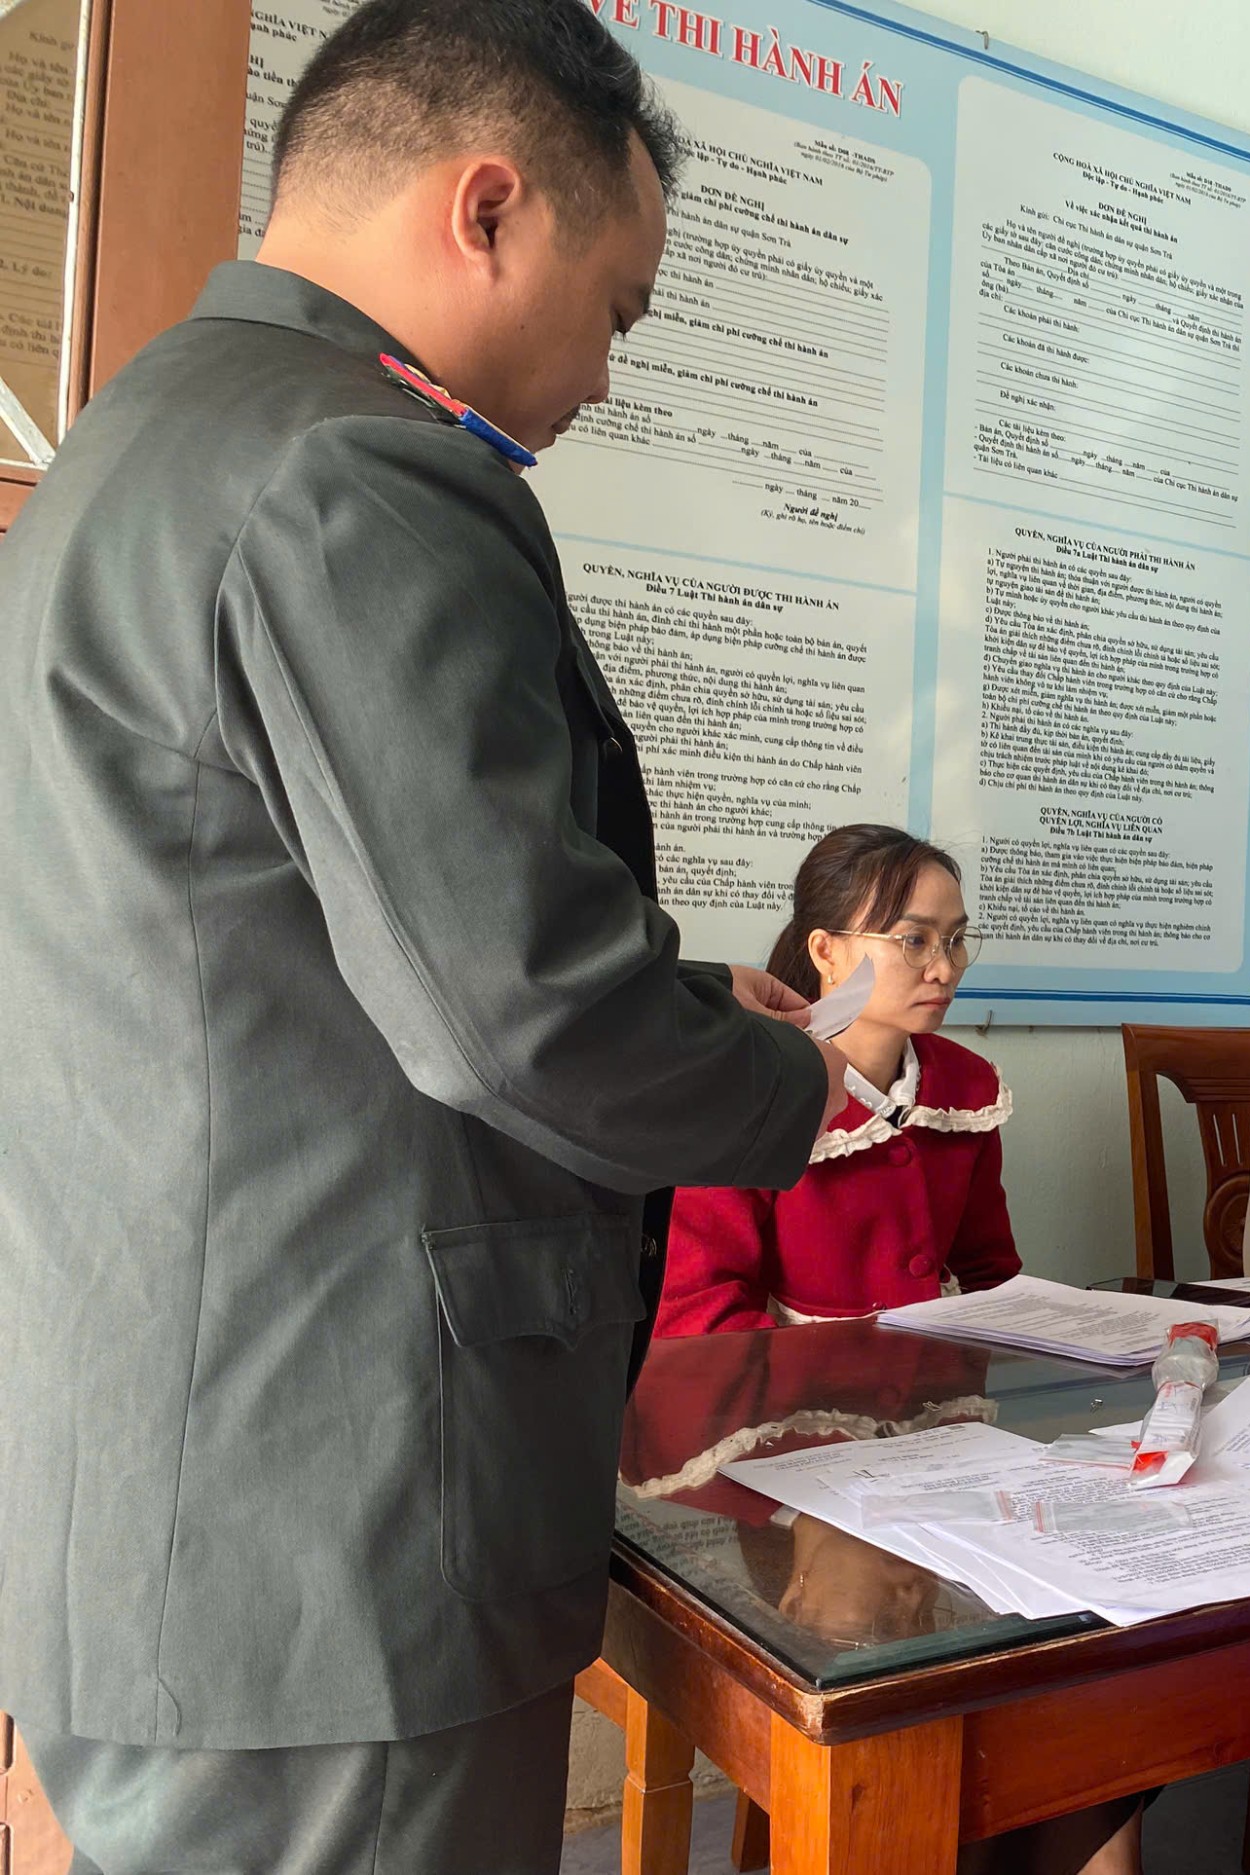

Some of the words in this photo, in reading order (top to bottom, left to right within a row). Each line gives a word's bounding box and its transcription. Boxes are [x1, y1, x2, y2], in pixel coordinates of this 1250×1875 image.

[650, 0, 721, 56] THI
[732, 27, 844, 97] HÀNH
[850, 61, 903, 117] ÁN
[694, 140, 706, 150] XÃ
[709, 145, 726, 158] HỘI
[728, 151, 746, 162] CHỦ
[750, 157, 779, 172] NGHĨA
[780, 166, 800, 178] VIỆT
[803, 173, 822, 185] NAM
[729, 161, 739, 170] do
[1052, 152, 1074, 165] CỘNG
[1104, 169, 1117, 181] HỘI
[1135, 180, 1157, 193] NGHĨA
[1158, 188, 1174, 198] VIỆT
[1175, 193, 1191, 205] NAM
[700, 185, 721, 196] ĐƠN
[740, 195, 764, 211] NGHỊ
[761, 209, 775, 223] chế
[777, 218, 788, 226] thi
[789, 221, 809, 233] hành
[811, 227, 821, 236] án
[822, 231, 837, 240] dân
[839, 236, 848, 245] sự
[1098, 202, 1114, 212] ĐƠN
[1127, 211, 1146, 225] NGHỊ
[681, 210, 700, 222] hành
[702, 217, 712, 225] án
[713, 219, 728, 230] dân
[730, 225, 739, 234] sự
[740, 229, 759, 238] quận
[761, 232, 776, 243] Sơn
[778, 236, 791, 247] Trà
[614, 399, 631, 412] liệu
[633, 402, 651, 413] kèm
[654, 407, 672, 417] theo
[765, 483, 783, 493] ngày
[796, 488, 817, 500] tháng
[832, 496, 848, 505] năm
[784, 503, 808, 514] Người
[1046, 534, 1072, 545] NGHĨA
[1073, 539, 1084, 551] VỤ
[1085, 541, 1101, 552] CỦA
[1103, 545, 1128, 557] NGƯỜI
[1148, 555, 1161, 563] THI
[1163, 558, 1184, 568] HÀNH
[1185, 561, 1195, 570] ÁN
[627, 570, 662, 584] NGHĨA
[664, 575, 680, 589] VỤ
[681, 577, 704, 589] CỦA
[706, 582, 740, 594] NGƯỜI
[743, 587, 772, 600] ĐƯỢC
[775, 592, 792, 602] THI
[795, 596, 823, 607] HÀNH
[826, 599, 838, 609] ÁN
[646, 583, 666, 594] Điều
[677, 588, 698, 599] Luật
[700, 591, 715, 601] Thi
[718, 594, 739, 605] hành
[742, 598, 752, 607] án
[754, 600, 770, 610] dân
[773, 605, 783, 613] sự
[566, 594, 589, 607] gười
[590, 596, 613, 610] được
[614, 599, 626, 607] thi
[628, 600, 649, 610] hành
[651, 603, 662, 612] án
[664, 606, 675, 614] có
[676, 608, 690, 616] các
[692, 610, 719, 623] quyền
[720, 615, 733, 623] sau
[735, 616, 752, 626] đây:
[588, 629, 611, 641] trong
[613, 631, 634, 644] Luật
[636, 635, 654, 647] này;
[601, 663, 616, 674] địa
[645, 668, 678, 681] phương
[679, 672, 700, 683] thức,
[702, 675, 716, 685] nội
[718, 677, 738, 689] dung
[740, 680, 751, 688] thi
[753, 680, 773, 691] hành
[775, 684, 787, 693] án;
[645, 744, 659, 754] phí
[662, 746, 677, 755] xác
[679, 749, 701, 757] minh
[702, 748, 721, 759] điều
[723, 752, 741, 761] kiện
[743, 753, 754, 762] thi
[756, 755, 776, 764] hành
[778, 757, 788, 765] án
[789, 758, 800, 767] do
[802, 759, 823, 771] Chấp
[824, 762, 843, 771] hành
[845, 765, 862, 773] viên
[1071, 809, 1096, 819] NGHĨA
[1096, 812, 1107, 821] VỤ
[1109, 813, 1125, 821] CỦA
[1126, 815, 1150, 823] NGƯỜI
[1151, 816, 1163, 825] CÓ
[671, 897, 690, 906] theo
[691, 900, 707, 908] quy
[709, 899, 727, 908] định
[729, 900, 744, 908] của
[746, 899, 764, 910] Luật
